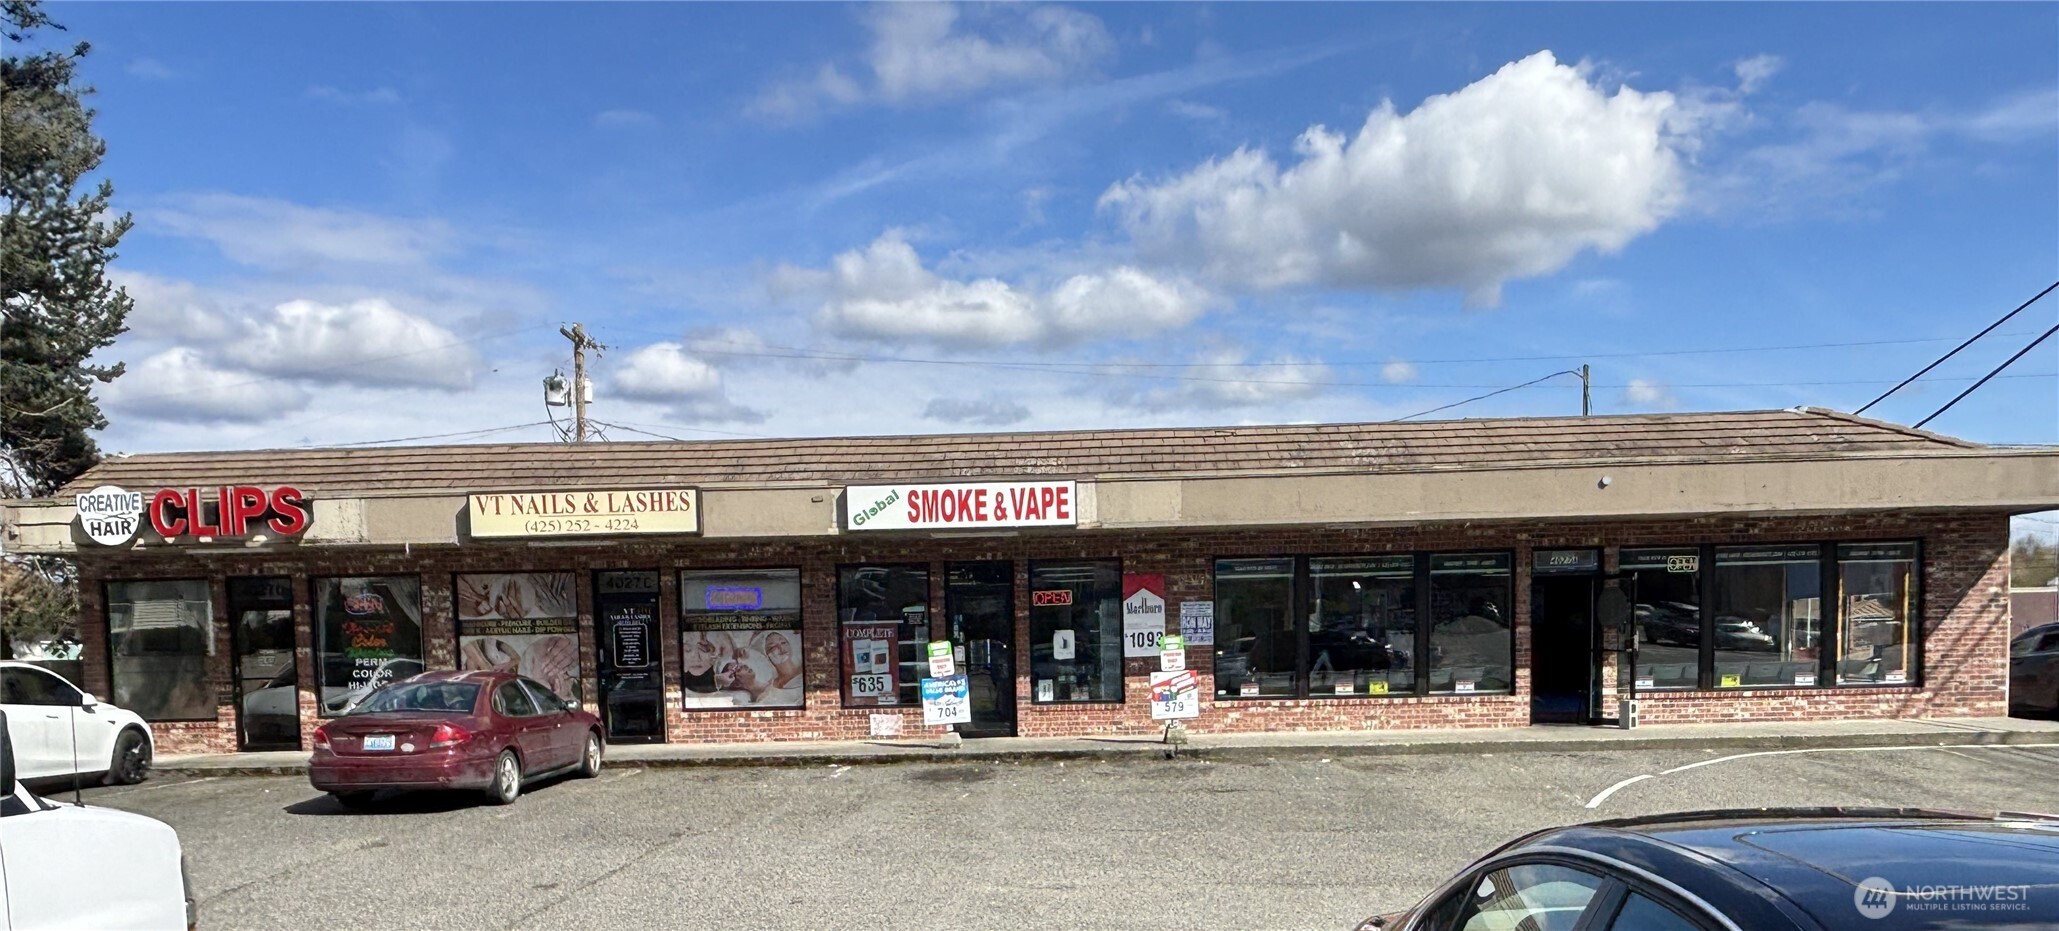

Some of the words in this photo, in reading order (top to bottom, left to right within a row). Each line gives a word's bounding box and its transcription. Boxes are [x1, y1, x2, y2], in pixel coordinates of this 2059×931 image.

[79, 493, 140, 512] CREATIVE
[475, 495, 504, 516] VT
[511, 494, 576, 516] NAILS
[583, 492, 599, 514] &
[607, 491, 690, 513] LASHES
[852, 489, 900, 526] Global
[907, 488, 988, 523] SMOKE
[993, 491, 1008, 521] &
[1010, 486, 1069, 520] VAPE
[150, 486, 305, 537] CLIPS
[90, 520, 133, 537] HAIR
[525, 519, 562, 533] (425)
[565, 519, 591, 532] 252
[604, 518, 639, 531] 4224
[1034, 590, 1071, 606] OPEN
[1126, 597, 1162, 615] Marlboro
[846, 627, 895, 638] COMPLETE
[355, 658, 387, 667] PERM
[937, 706, 957, 718] 704
[1164, 701, 1184, 712] 579
